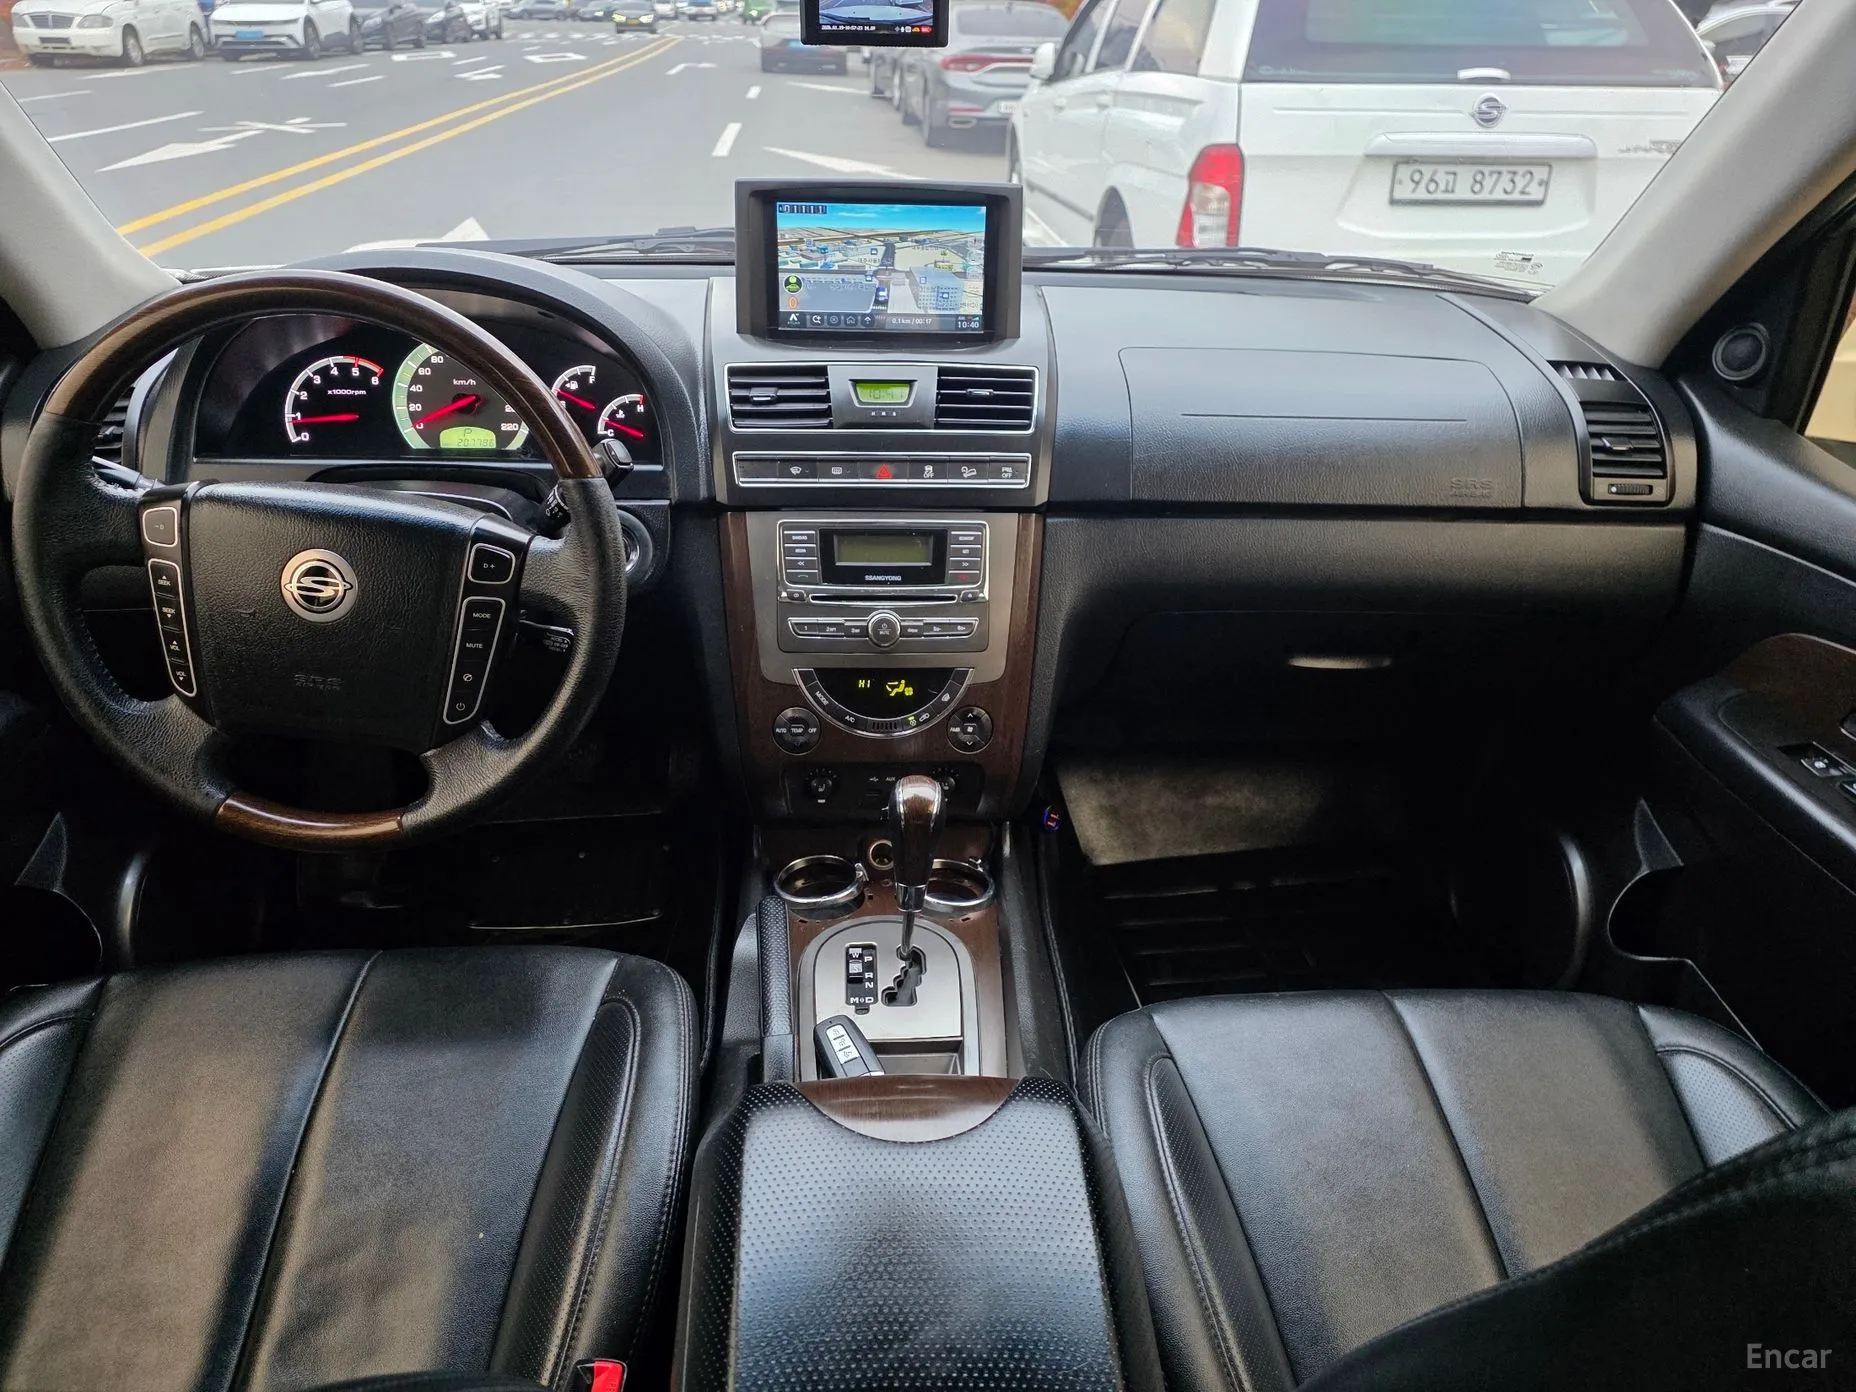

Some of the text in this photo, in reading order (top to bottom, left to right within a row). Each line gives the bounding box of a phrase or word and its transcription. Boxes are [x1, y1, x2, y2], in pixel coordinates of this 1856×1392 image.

[1470, 169, 1534, 196] 8732
[430, 356, 444, 364] 80
[330, 368, 338, 376] 4
[351, 367, 360, 377] 5
[418, 367, 432, 376] 60
[313, 376, 321, 385] 3
[371, 376, 380, 386] 6
[453, 378, 477, 386] km/h
[589, 375, 596, 384] F
[327, 388, 367, 396] x1000rpm
[409, 385, 423, 393] 40
[299, 391, 308, 400] 2
[408, 403, 422, 412] 20
[636, 404, 645, 413] H
[295, 412, 302, 421] 1
[500, 422, 519, 431] 220
[300, 432, 309, 441] 0
[463, 428, 472, 438] P
[607, 429, 615, 437] C
[864, 574, 902, 582] SSANGYONG
[814, 690, 830, 706] MODE
[865, 981, 874, 989] N
